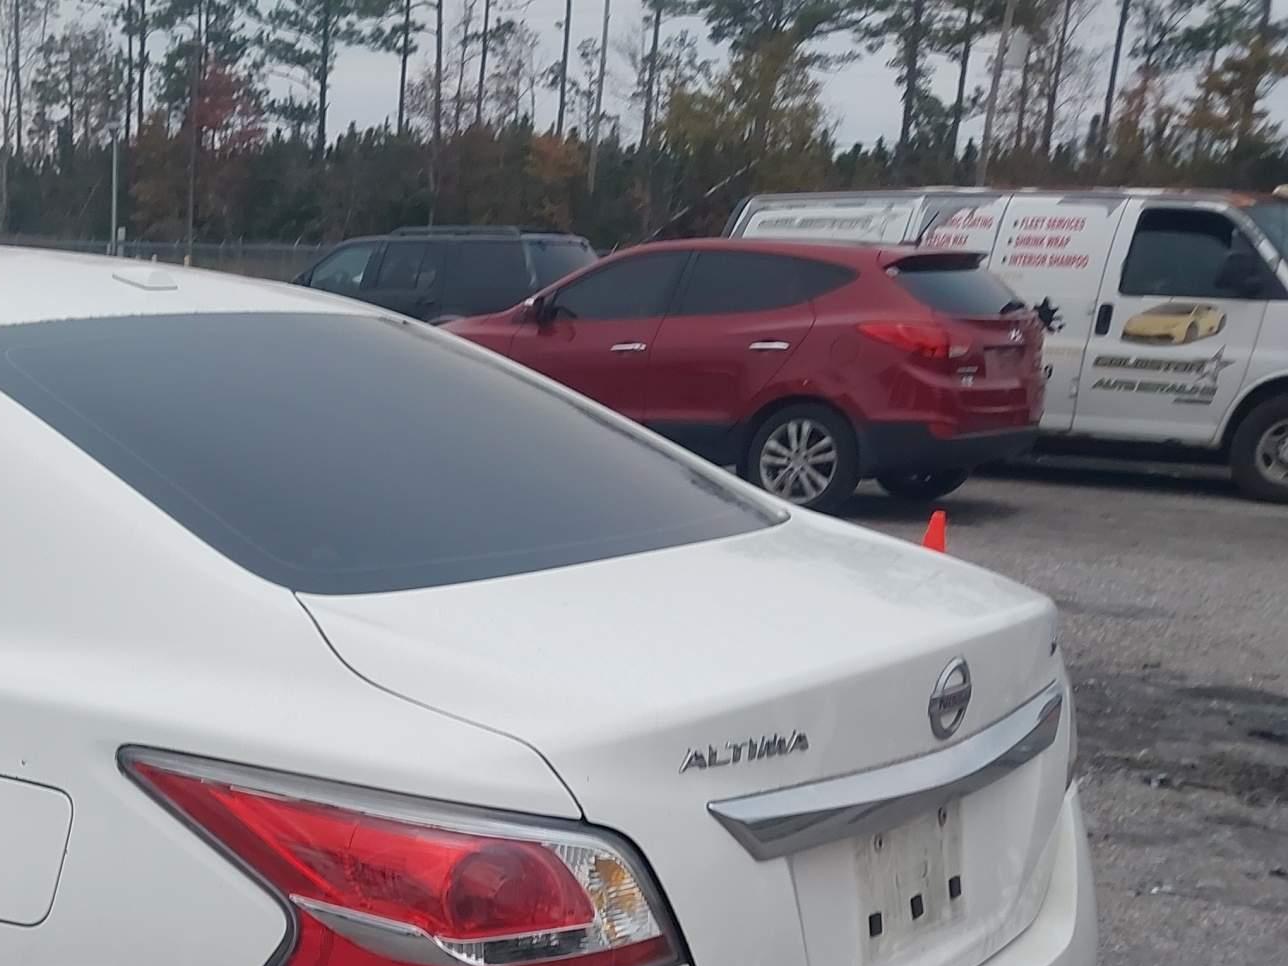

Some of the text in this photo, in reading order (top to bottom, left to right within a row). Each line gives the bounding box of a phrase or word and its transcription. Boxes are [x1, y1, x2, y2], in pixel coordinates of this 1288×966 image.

[1019, 216, 1087, 232] FLEET SERVICES
[1014, 235, 1072, 248] SHRINK WRAP
[1008, 253, 1090, 269] INTERIOR SHAMPOO
[1091, 377, 1137, 392] AUTO
[678, 729, 809, 774] ALTIMA
